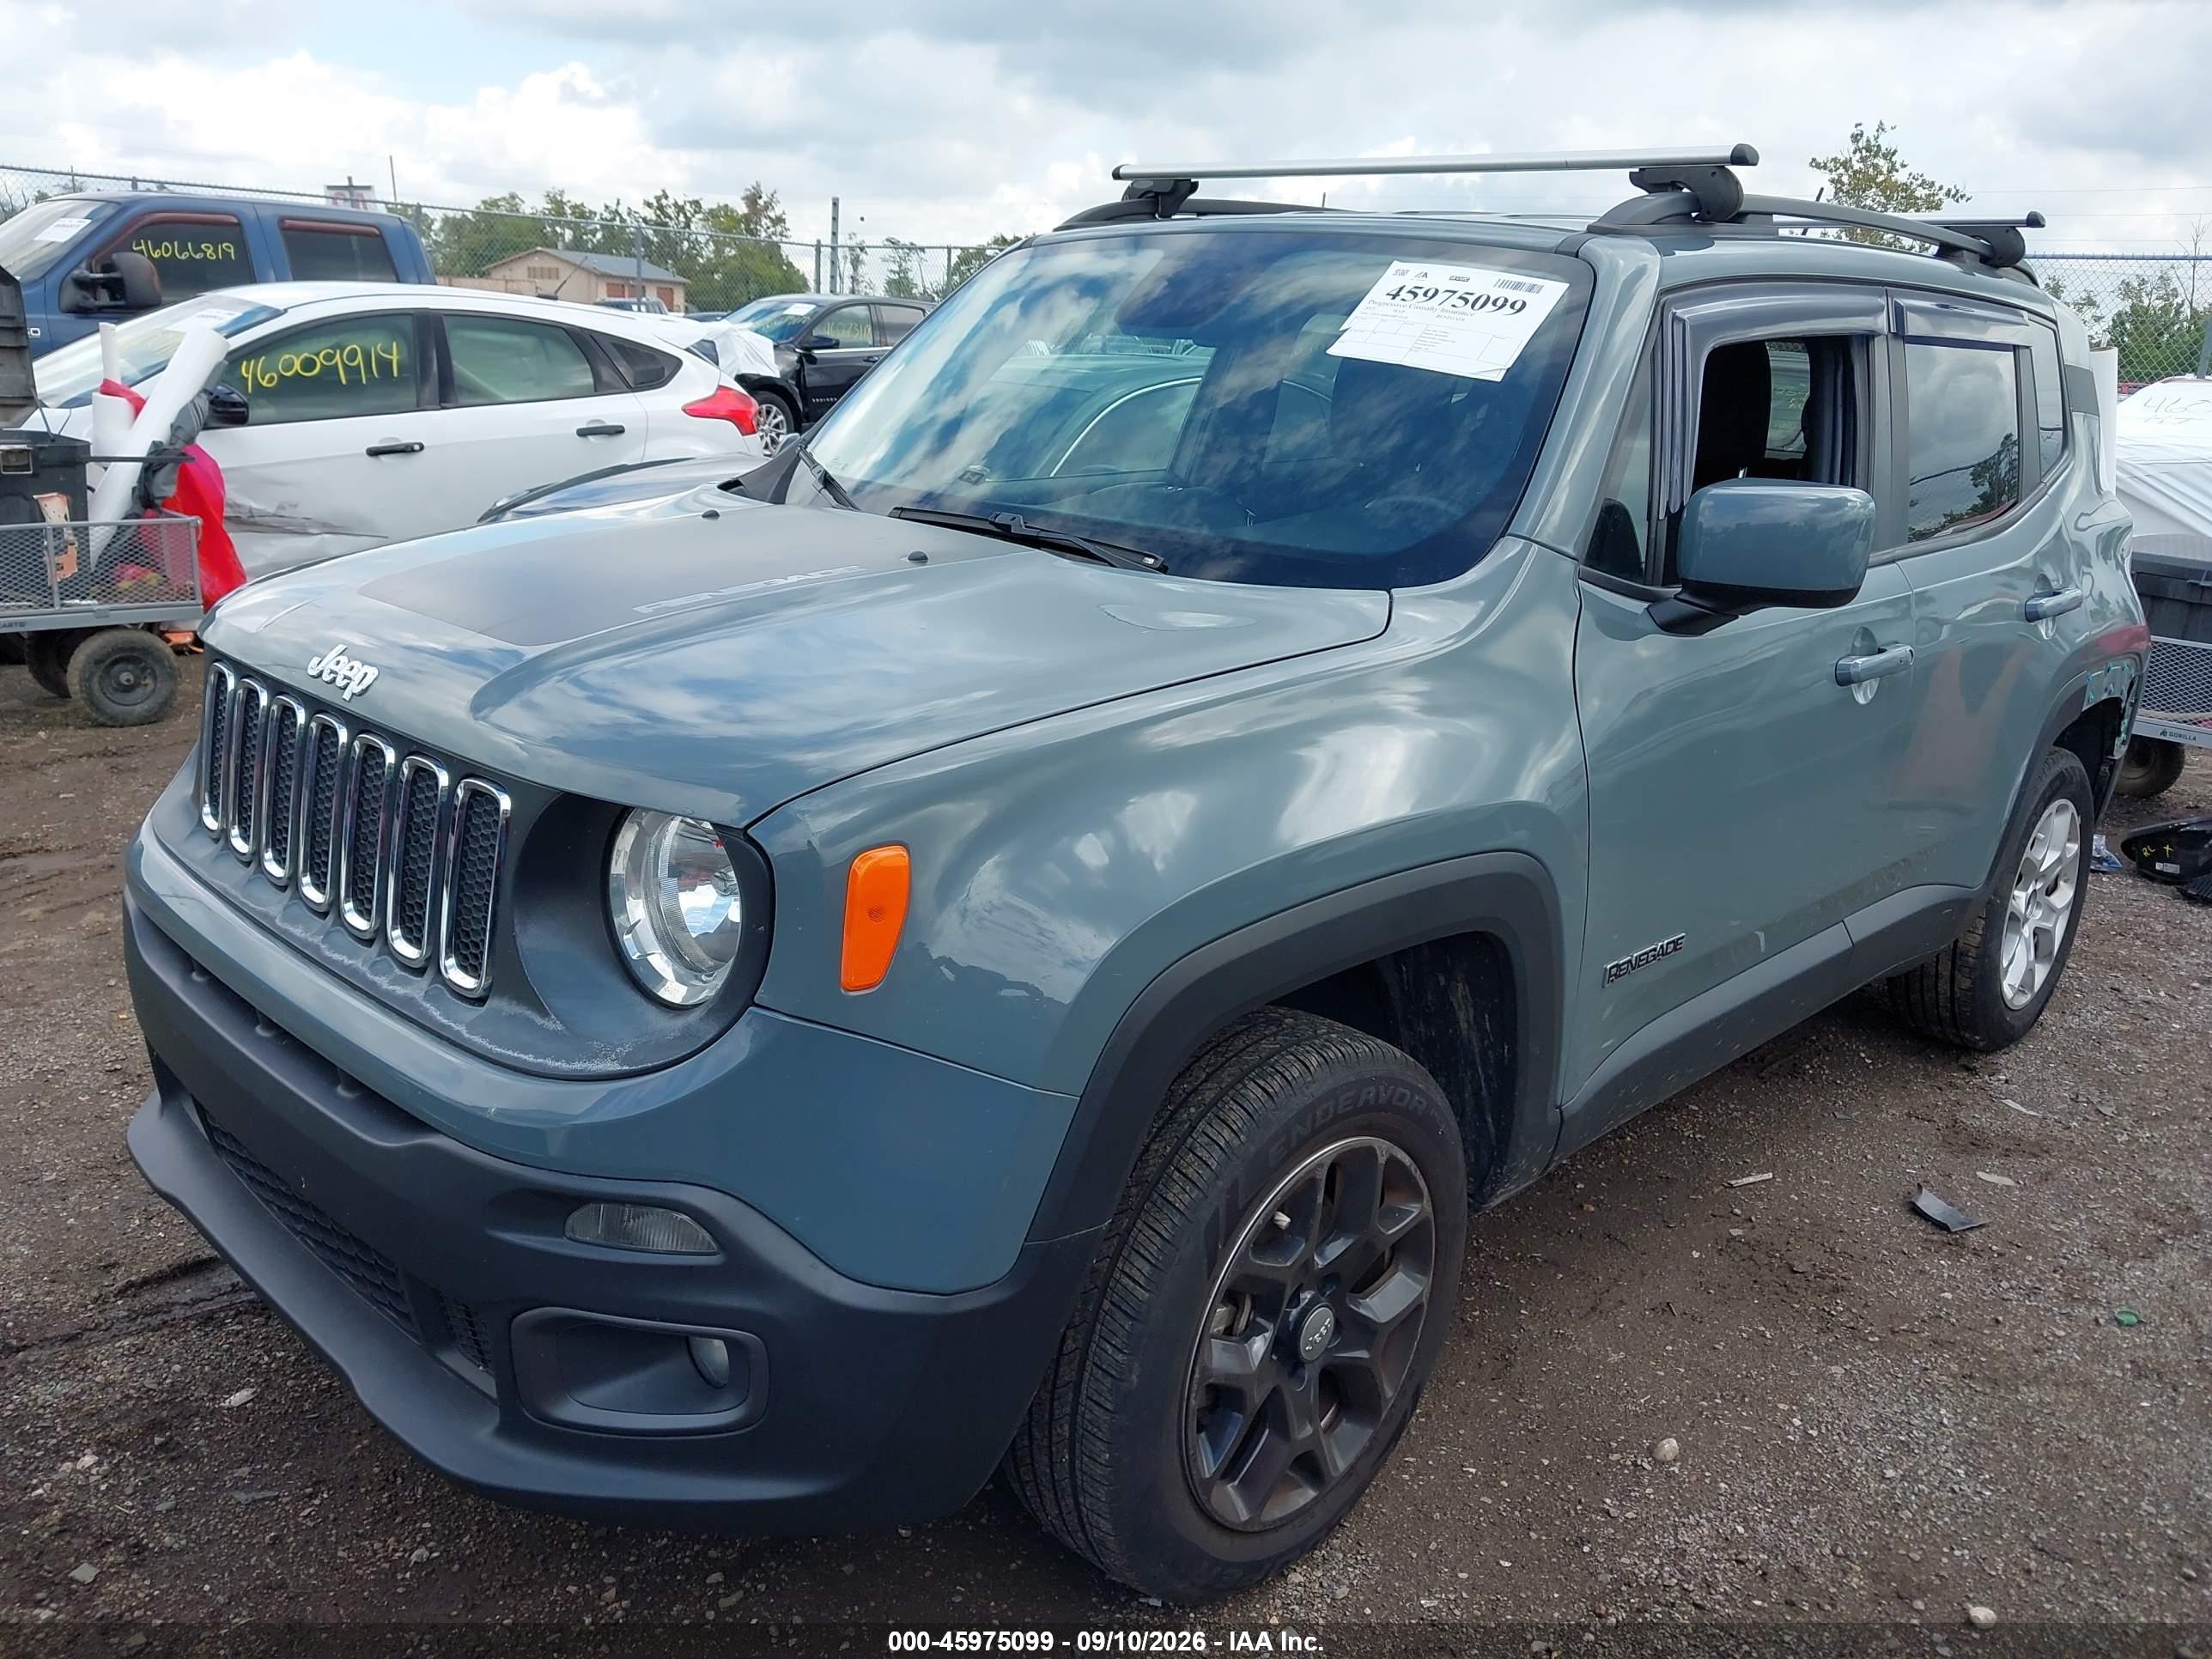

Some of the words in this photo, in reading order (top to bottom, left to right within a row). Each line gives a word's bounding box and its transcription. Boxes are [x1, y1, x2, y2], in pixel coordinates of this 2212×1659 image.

[132, 239, 235, 261] 46066819
[1385, 284, 1528, 316] 45975099
[240, 341, 398, 393] 46009914
[307, 643, 379, 702] Jeep
[2168, 731, 2197, 741] GORILLA
[1602, 933, 1686, 988] RENEGADE
